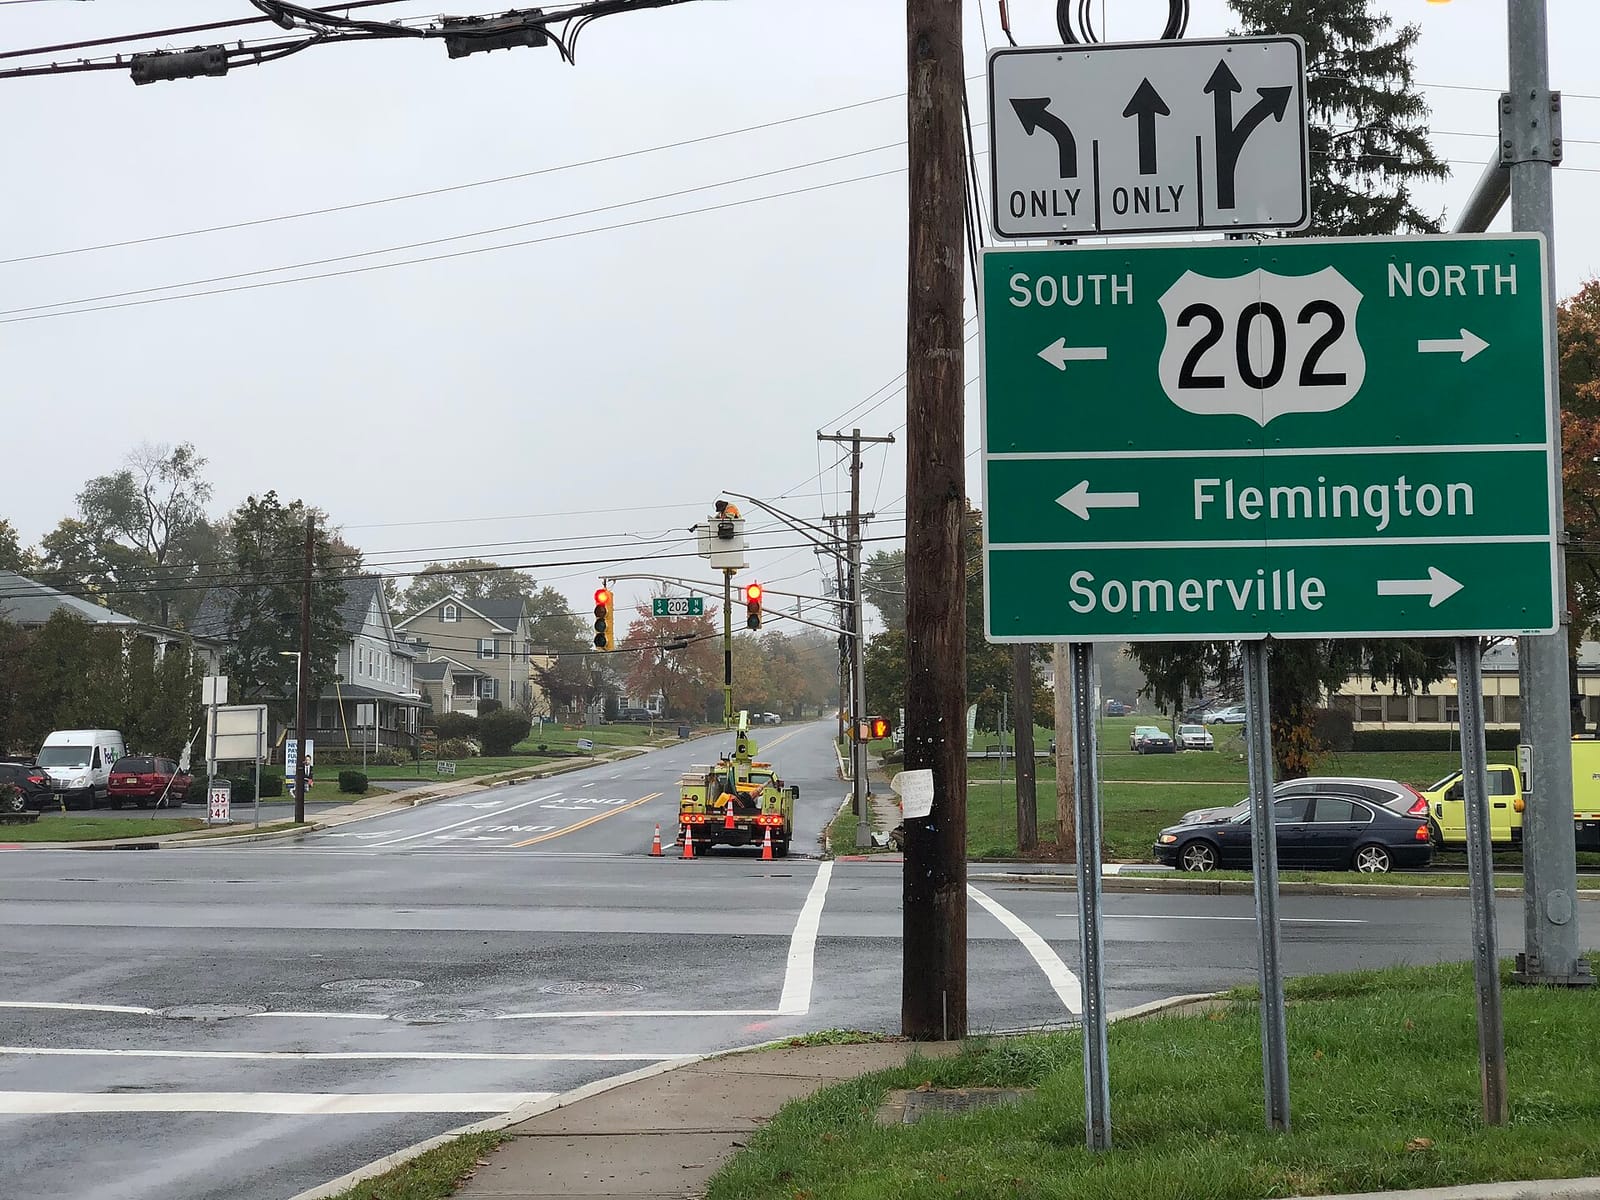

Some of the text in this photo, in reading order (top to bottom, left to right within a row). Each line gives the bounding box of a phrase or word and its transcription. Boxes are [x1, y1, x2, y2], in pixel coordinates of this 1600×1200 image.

[1009, 188, 1081, 219] ONLY
[1112, 184, 1184, 215] ONLY
[1008, 272, 1134, 308] SOUTH
[1386, 262, 1518, 298] NORTH
[1175, 299, 1348, 390] 202
[1193, 475, 1475, 532] Flemington
[669, 602, 688, 612] 202
[1067, 568, 1327, 614] Somerville
